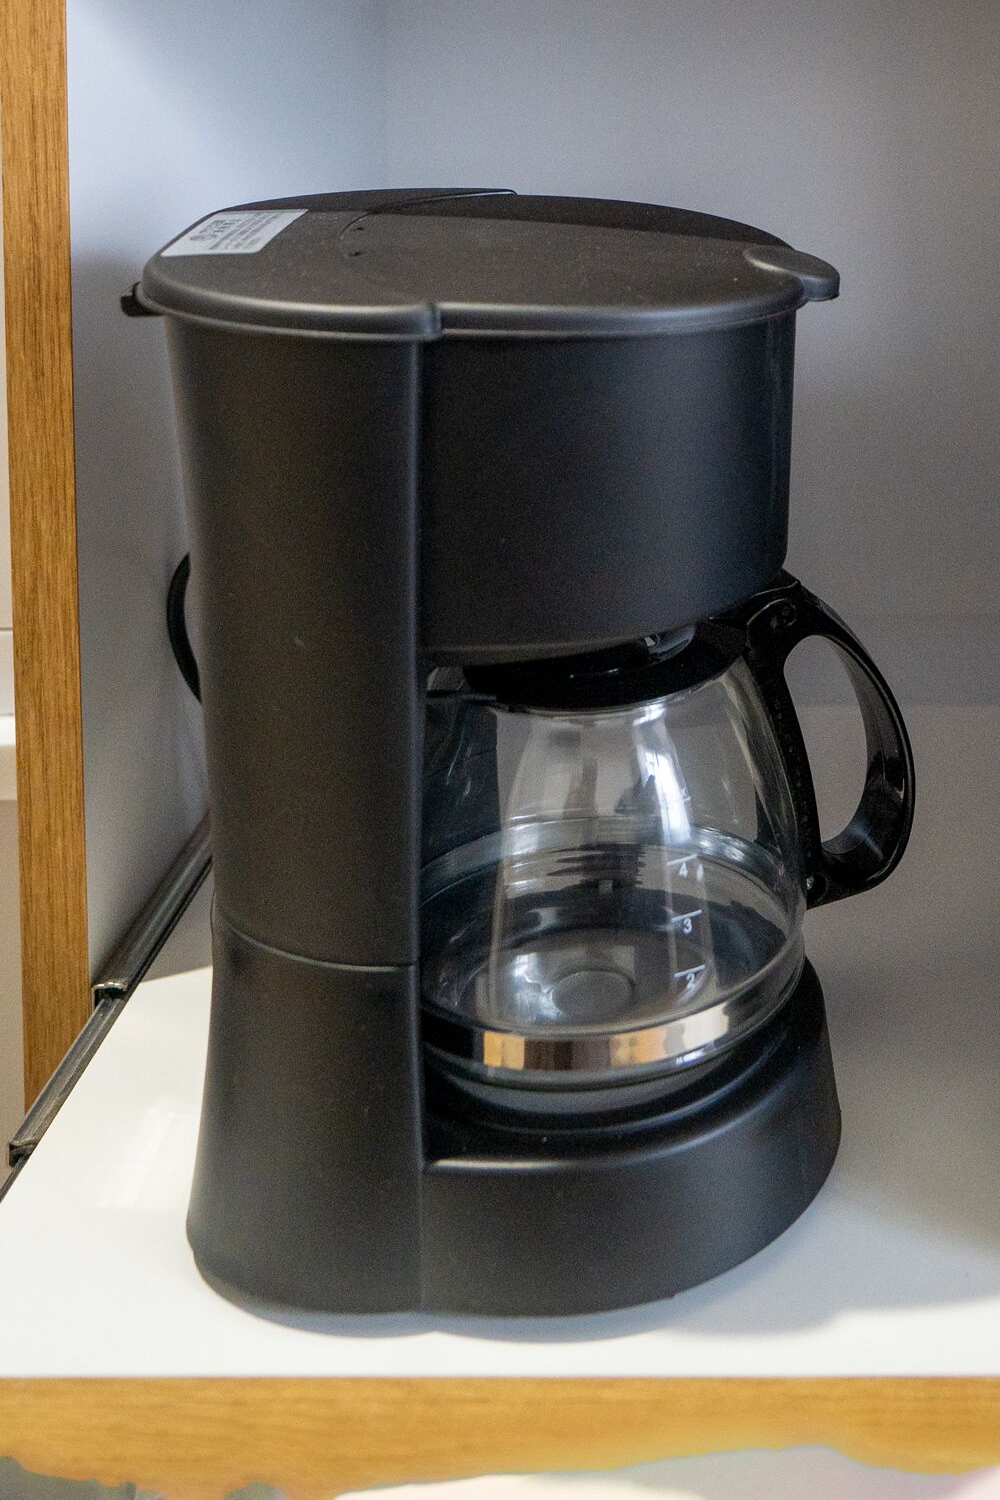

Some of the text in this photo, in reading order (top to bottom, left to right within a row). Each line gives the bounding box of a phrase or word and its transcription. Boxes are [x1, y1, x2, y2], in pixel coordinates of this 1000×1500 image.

[679, 862, 688, 877] 4
[683, 918, 692, 934] 3
[686, 973, 696, 991] 2
